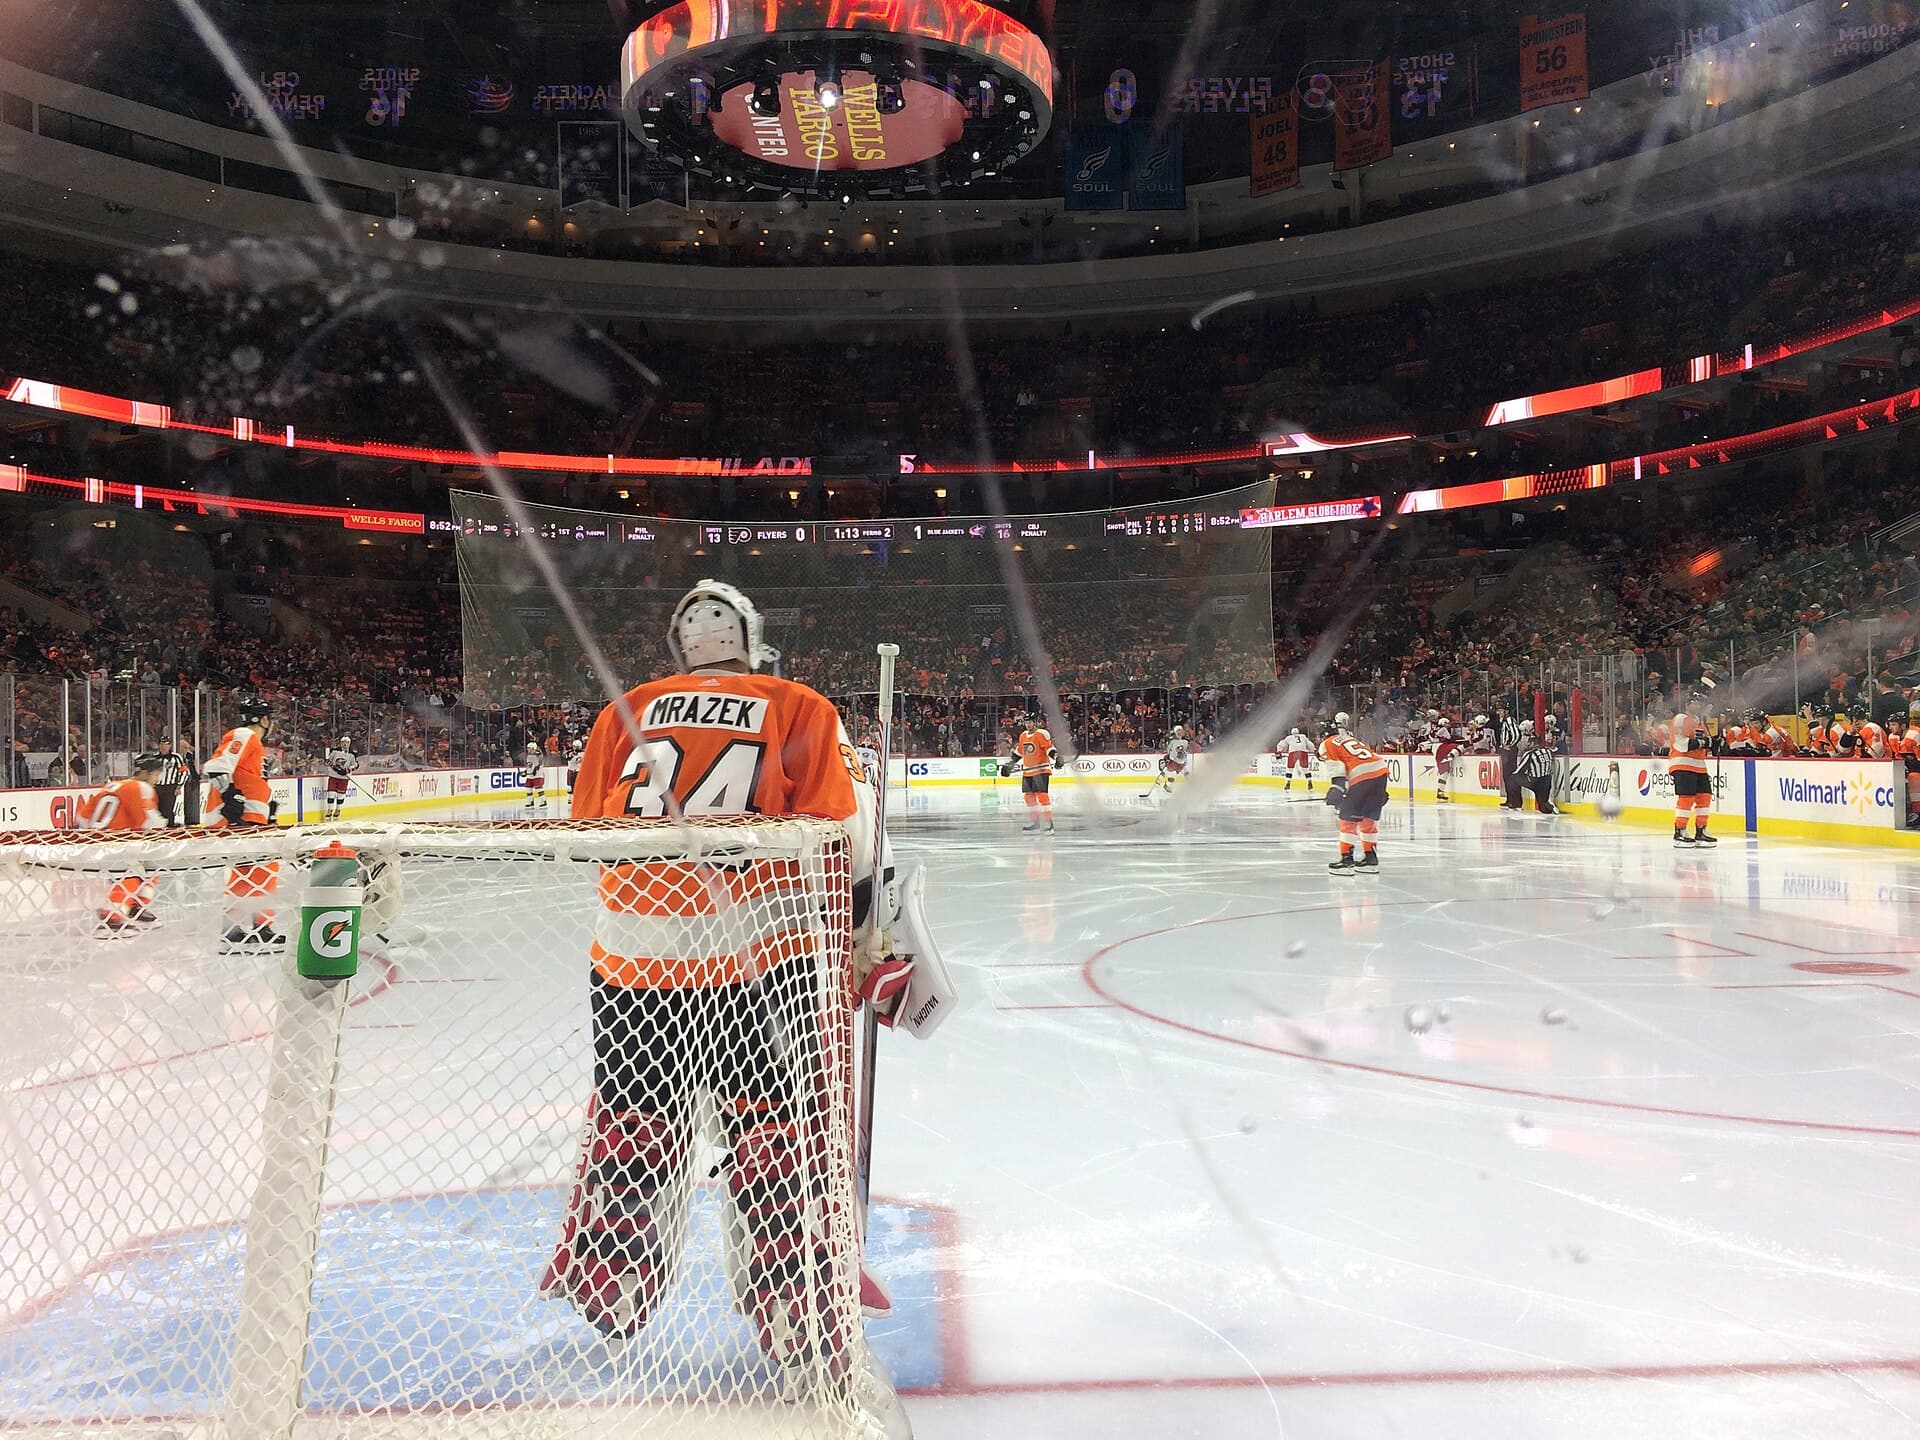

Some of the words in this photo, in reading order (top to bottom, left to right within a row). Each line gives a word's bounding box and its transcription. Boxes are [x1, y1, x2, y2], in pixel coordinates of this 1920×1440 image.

[1535, 44, 1567, 74] 56
[744, 93, 790, 157] NTER
[788, 86, 840, 161] FARGO
[843, 82, 886, 161] WELLS
[1256, 121, 1293, 141] JOEL
[1262, 140, 1287, 166] 48
[1072, 182, 1113, 192] SOUL
[1135, 182, 1177, 192] SOUL
[350, 513, 387, 527] WELLS
[387, 517, 422, 529] FARGO
[1259, 508, 1306, 524] HARLEM
[914, 525, 922, 540] 1
[1127, 520, 1142, 529] PHL
[628, 533, 656, 541] PENALTY
[707, 533, 721, 544] 13
[757, 531, 787, 540] FLYERS
[795, 527, 805, 542] 0
[834, 527, 859, 539] 1:13
[883, 527, 891, 538] 2
[998, 529, 1011, 539] 16
[1020, 530, 1047, 538] PENALTY
[648, 695, 758, 729] MRAZEK
[1106, 761, 1122, 769] KIA
[1132, 761, 1148, 769] KIA
[618, 737, 767, 817] 34
[1652, 773, 1675, 790] peps
[372, 777, 390, 796] FAST
[418, 774, 439, 797] xfinity
[1779, 776, 1847, 806] Walmart
[309, 910, 353, 958] G
[912, 993, 940, 1029] VAUGHN
